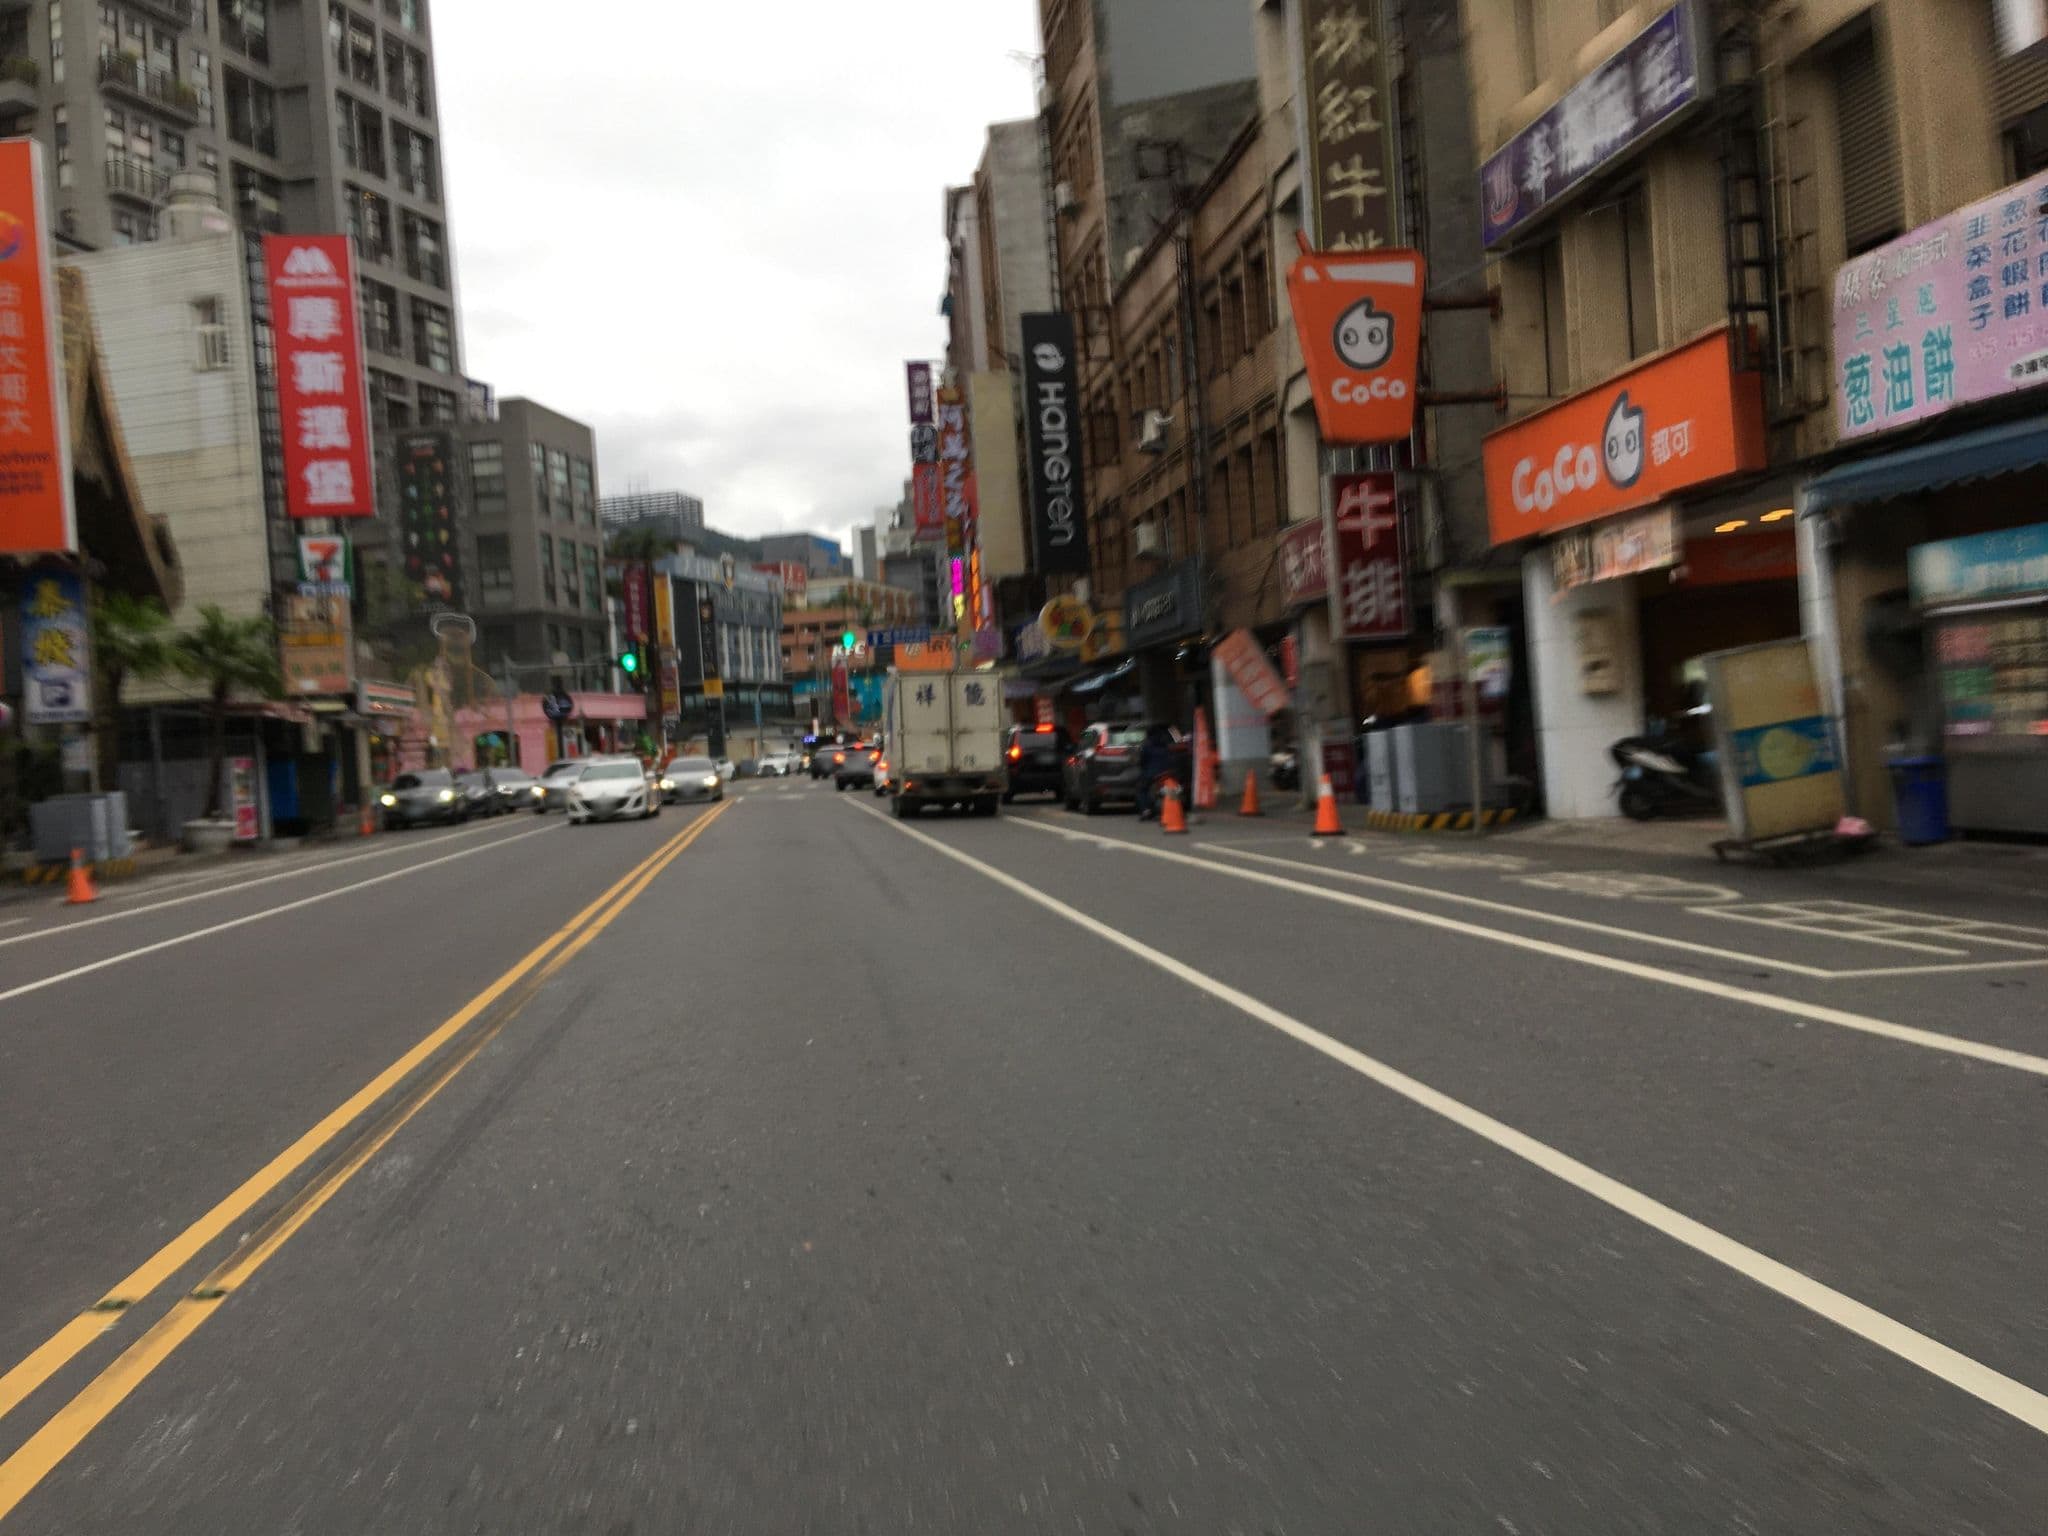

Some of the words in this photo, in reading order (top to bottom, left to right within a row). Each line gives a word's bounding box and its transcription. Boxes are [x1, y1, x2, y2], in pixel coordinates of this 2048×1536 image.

[1965, 212, 1993, 332] 韭菜盒子
[1331, 377, 1406, 404] CoCo
[1651, 420, 1690, 467] 都可
[1511, 444, 1597, 513] CoCo
